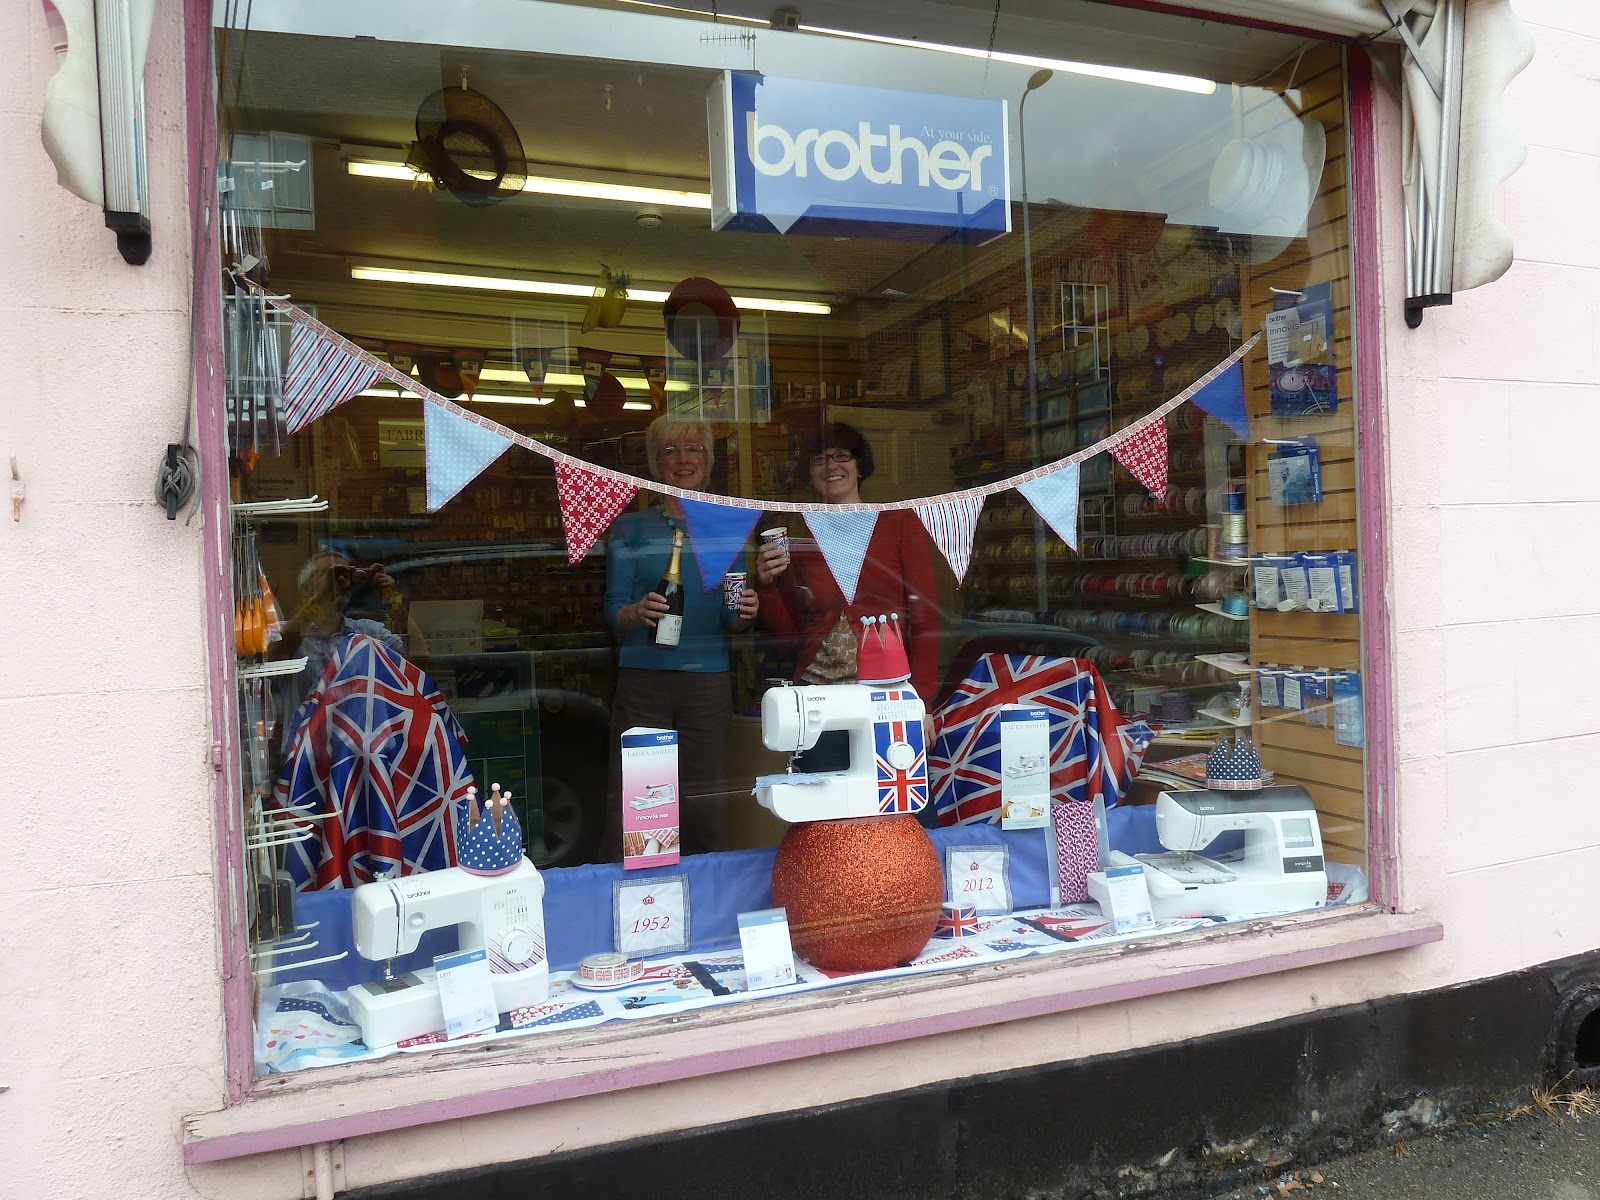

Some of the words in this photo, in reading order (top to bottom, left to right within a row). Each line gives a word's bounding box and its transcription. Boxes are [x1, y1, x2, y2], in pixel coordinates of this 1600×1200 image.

[921, 126, 935, 137] At
[938, 129, 964, 142] your
[967, 131, 993, 144] side.
[746, 110, 993, 192] brother
[651, 748, 676, 756] ASHLEY
[962, 877, 994, 893] 2012
[407, 890, 431, 899] brother
[631, 916, 671, 934] 1952
